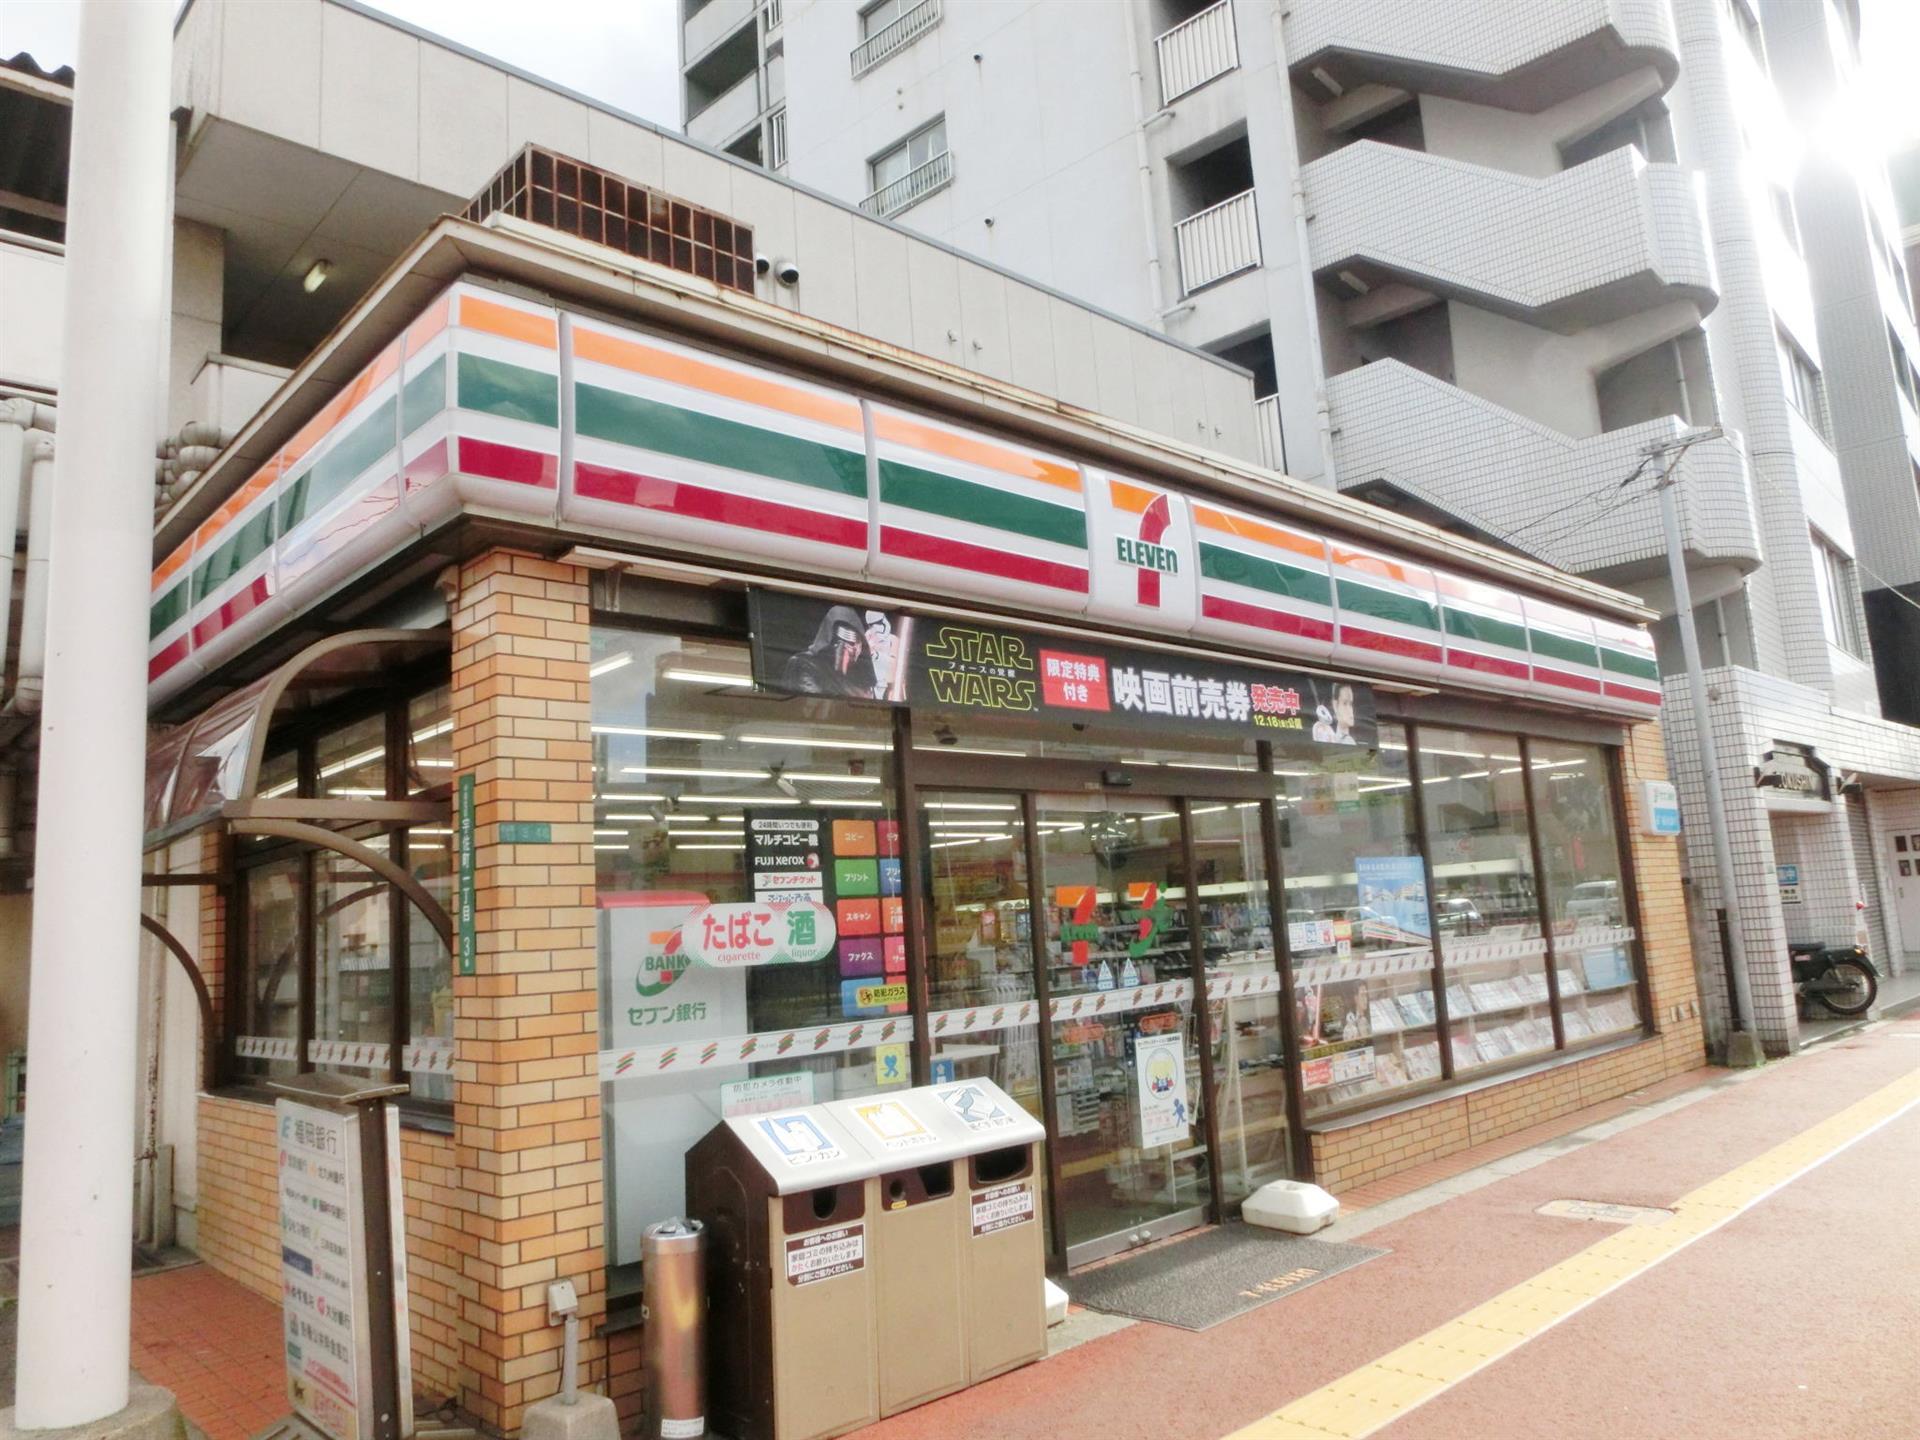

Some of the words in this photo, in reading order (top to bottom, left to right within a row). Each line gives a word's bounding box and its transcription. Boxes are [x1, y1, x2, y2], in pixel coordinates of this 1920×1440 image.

[926, 627, 1033, 671] STAR
[1046, 658, 1100, 682] 限定特典
[929, 669, 1035, 711] WARS
[1062, 682, 1089, 703] 付き
[1112, 667, 1250, 721] 映画前売券
[1250, 684, 1300, 716] 発売中
[754, 833, 819, 846] マルチコピー機
[844, 832, 865, 842] コピー
[755, 856, 774, 866] FUJI
[844, 873, 869, 882] プリント
[845, 912, 871, 922] スキャン
[702, 910, 775, 951] たばこ
[787, 910, 816, 946] 酒
[645, 953, 685, 972] BANK
[717, 951, 761, 963] cigarette
[628, 1002, 707, 1025] セブン銀行
